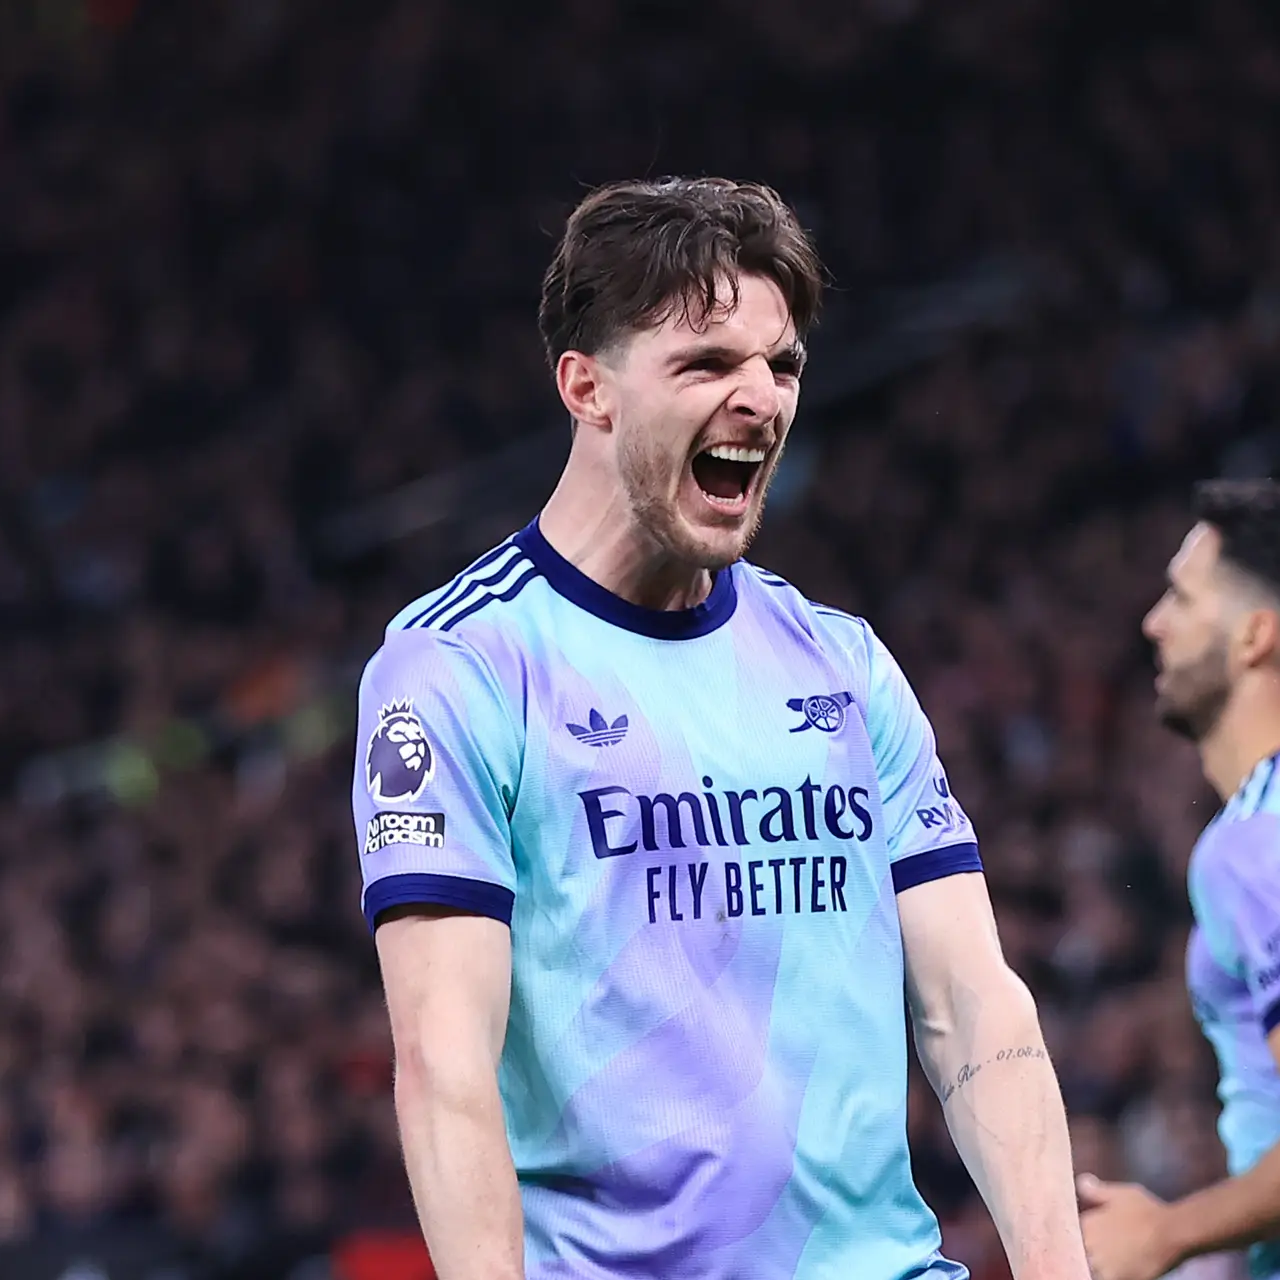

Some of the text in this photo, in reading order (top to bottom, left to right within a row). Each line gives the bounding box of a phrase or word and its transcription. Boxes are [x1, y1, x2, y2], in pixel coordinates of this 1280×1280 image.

[380, 814, 436, 832] room
[577, 773, 873, 860] Emirates
[646, 856, 848, 924] FLY BETTER
